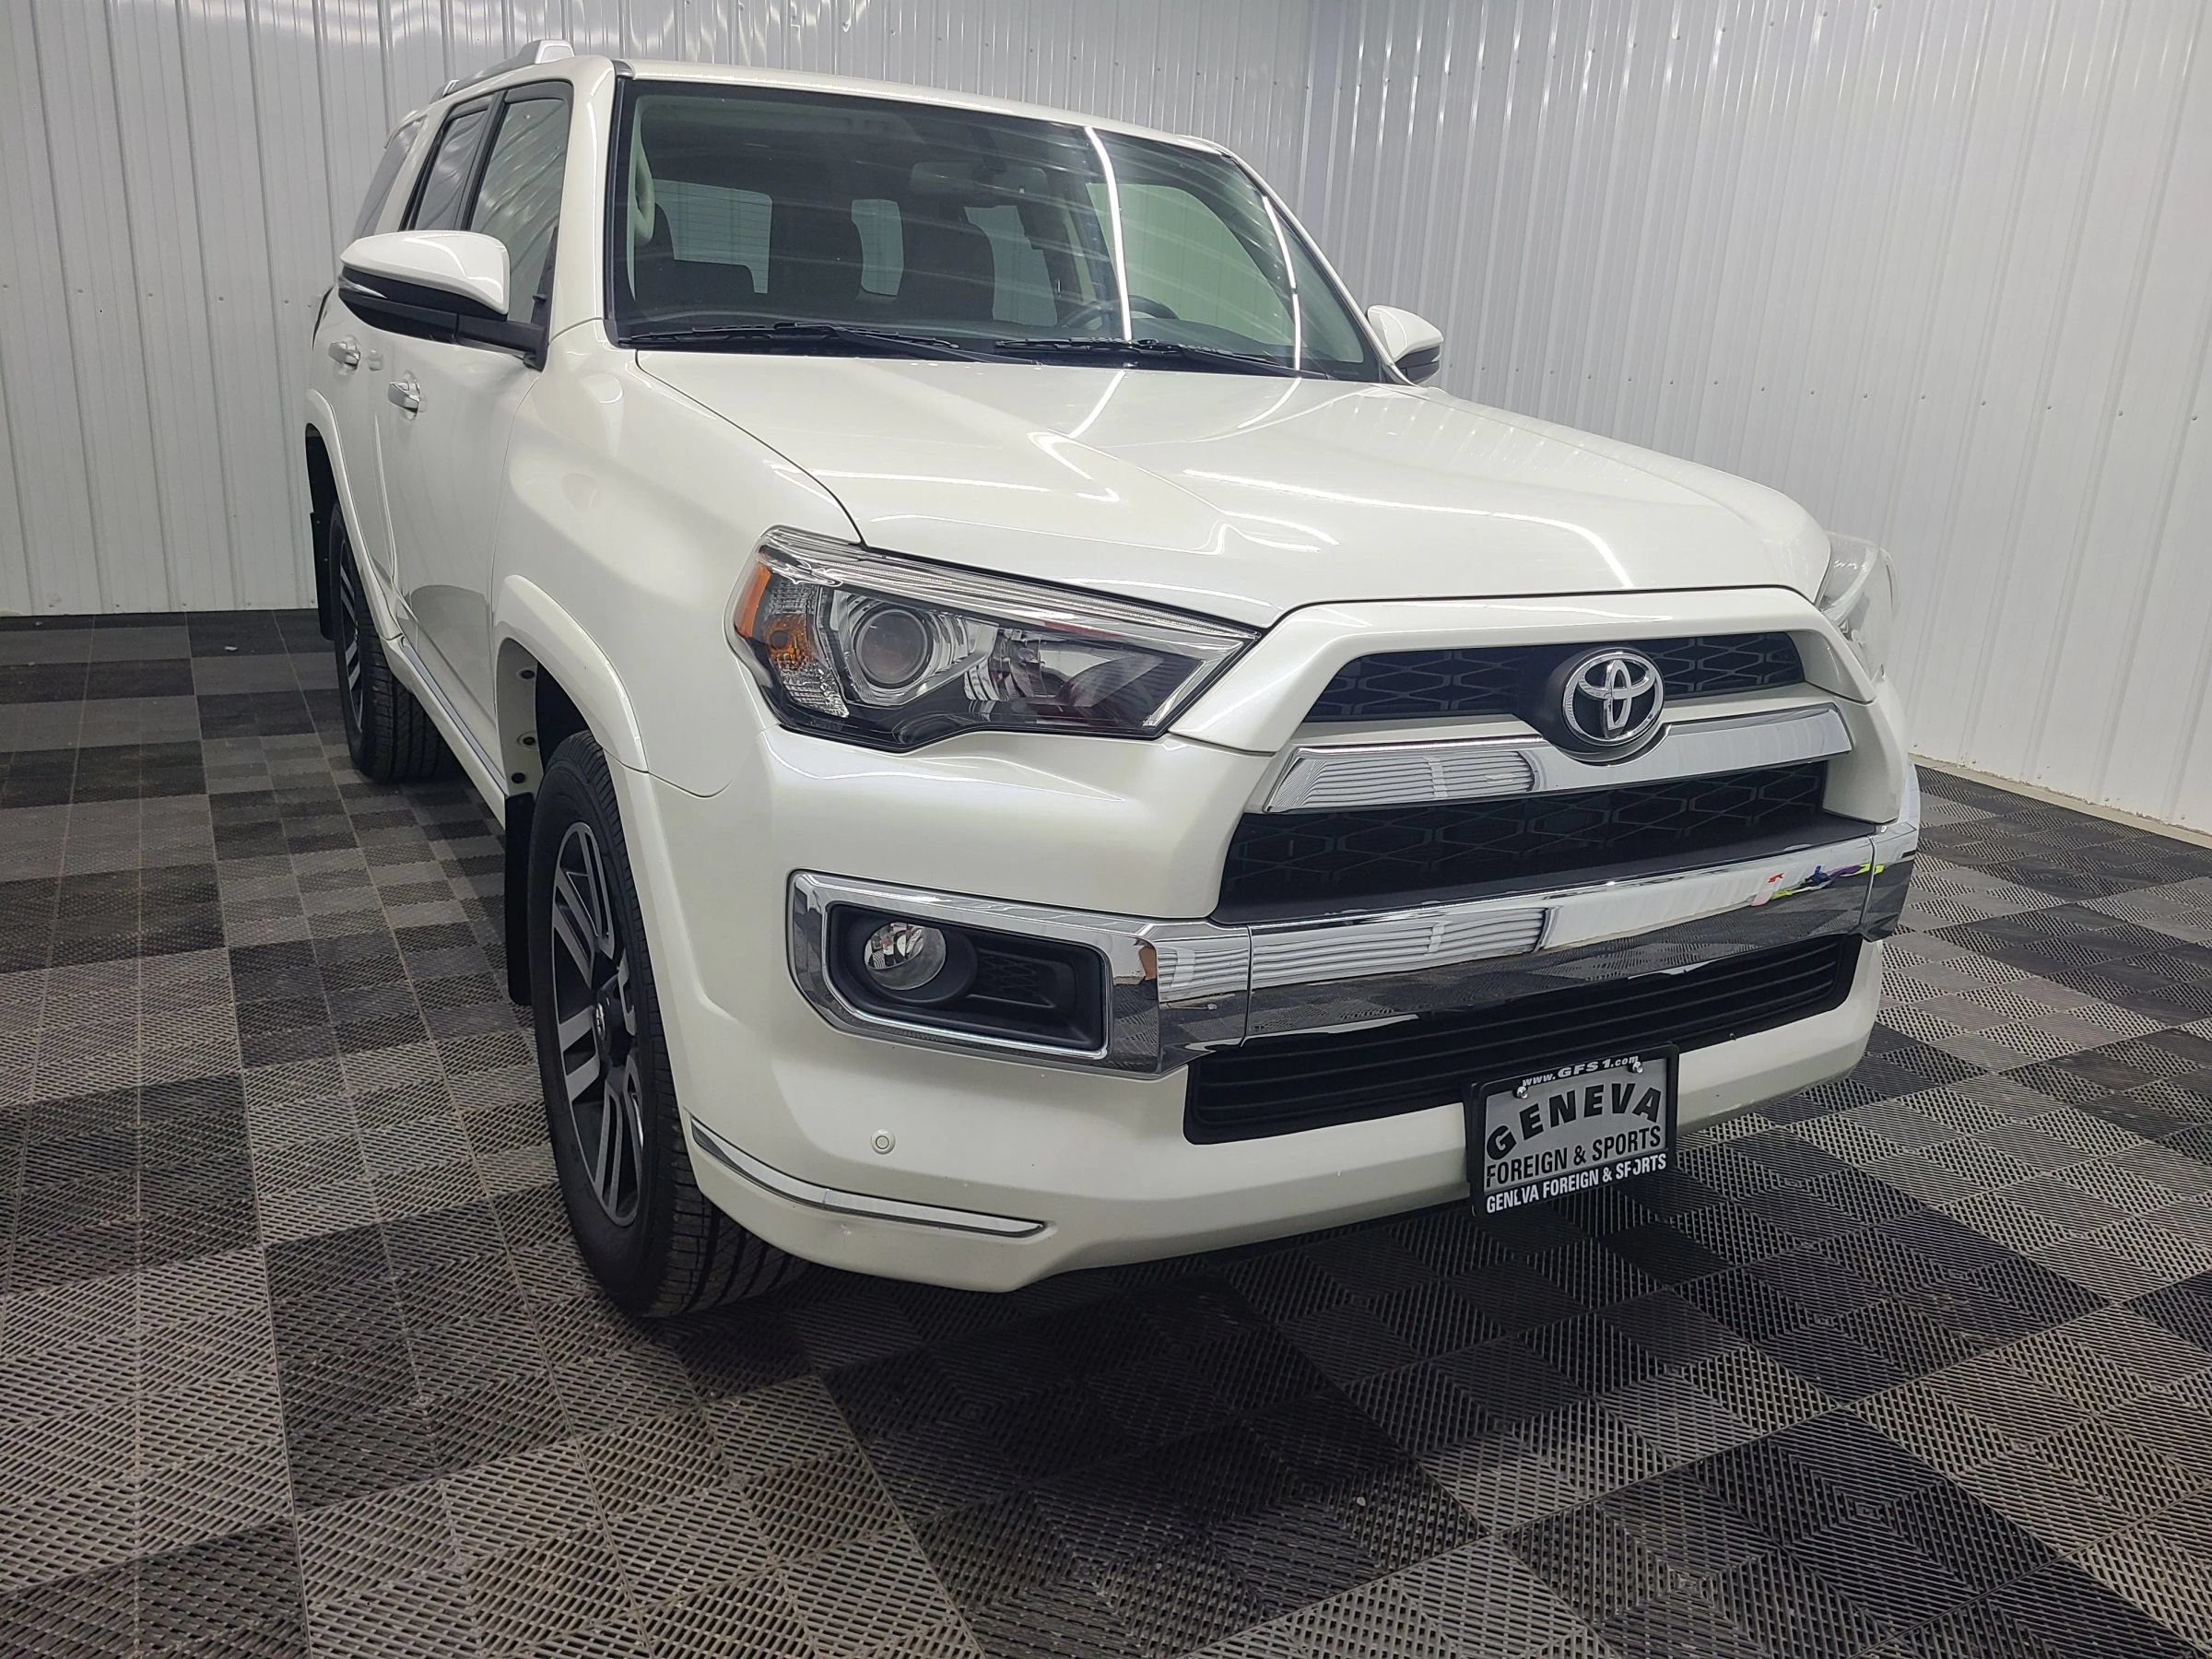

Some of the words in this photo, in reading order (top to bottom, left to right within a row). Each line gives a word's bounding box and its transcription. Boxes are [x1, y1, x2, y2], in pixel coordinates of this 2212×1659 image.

[1486, 1083, 1662, 1160] GENEVA
[1486, 1147, 1568, 1188] FOREIGN
[1573, 1145, 1586, 1166] &
[1592, 1125, 1661, 1161] SPORTS
[1543, 1169, 1599, 1198] FOREIGN
[1602, 1167, 1612, 1182] &
